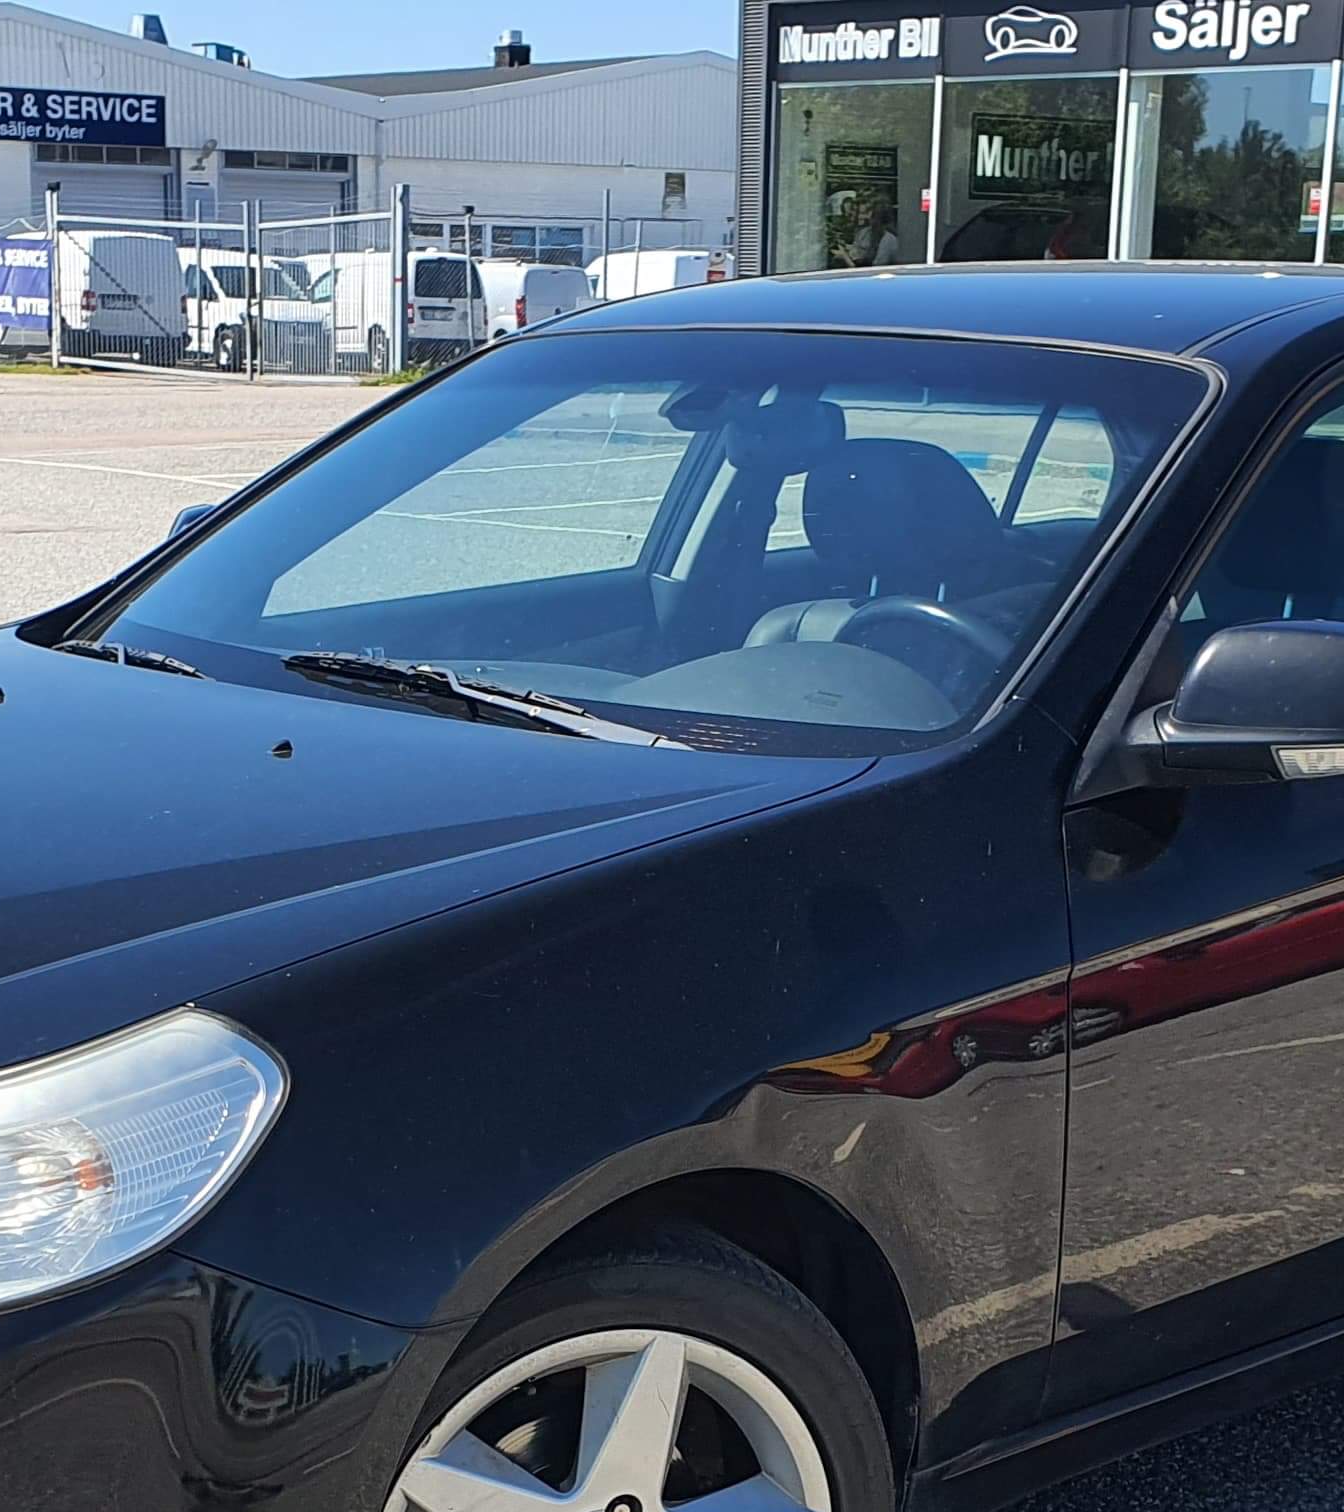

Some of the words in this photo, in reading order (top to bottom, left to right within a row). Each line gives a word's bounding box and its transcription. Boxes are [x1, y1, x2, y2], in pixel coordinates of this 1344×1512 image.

[779, 22, 895, 64] Munther
[1152, 0, 1310, 60] Säljer
[21, 93, 40, 118] &
[46, 94, 157, 123] SERVICE
[0, 120, 43, 140] säljer
[45, 122, 86, 141] byter
[976, 134, 1102, 182] Munther
[4, 248, 48, 268] SERVICE
